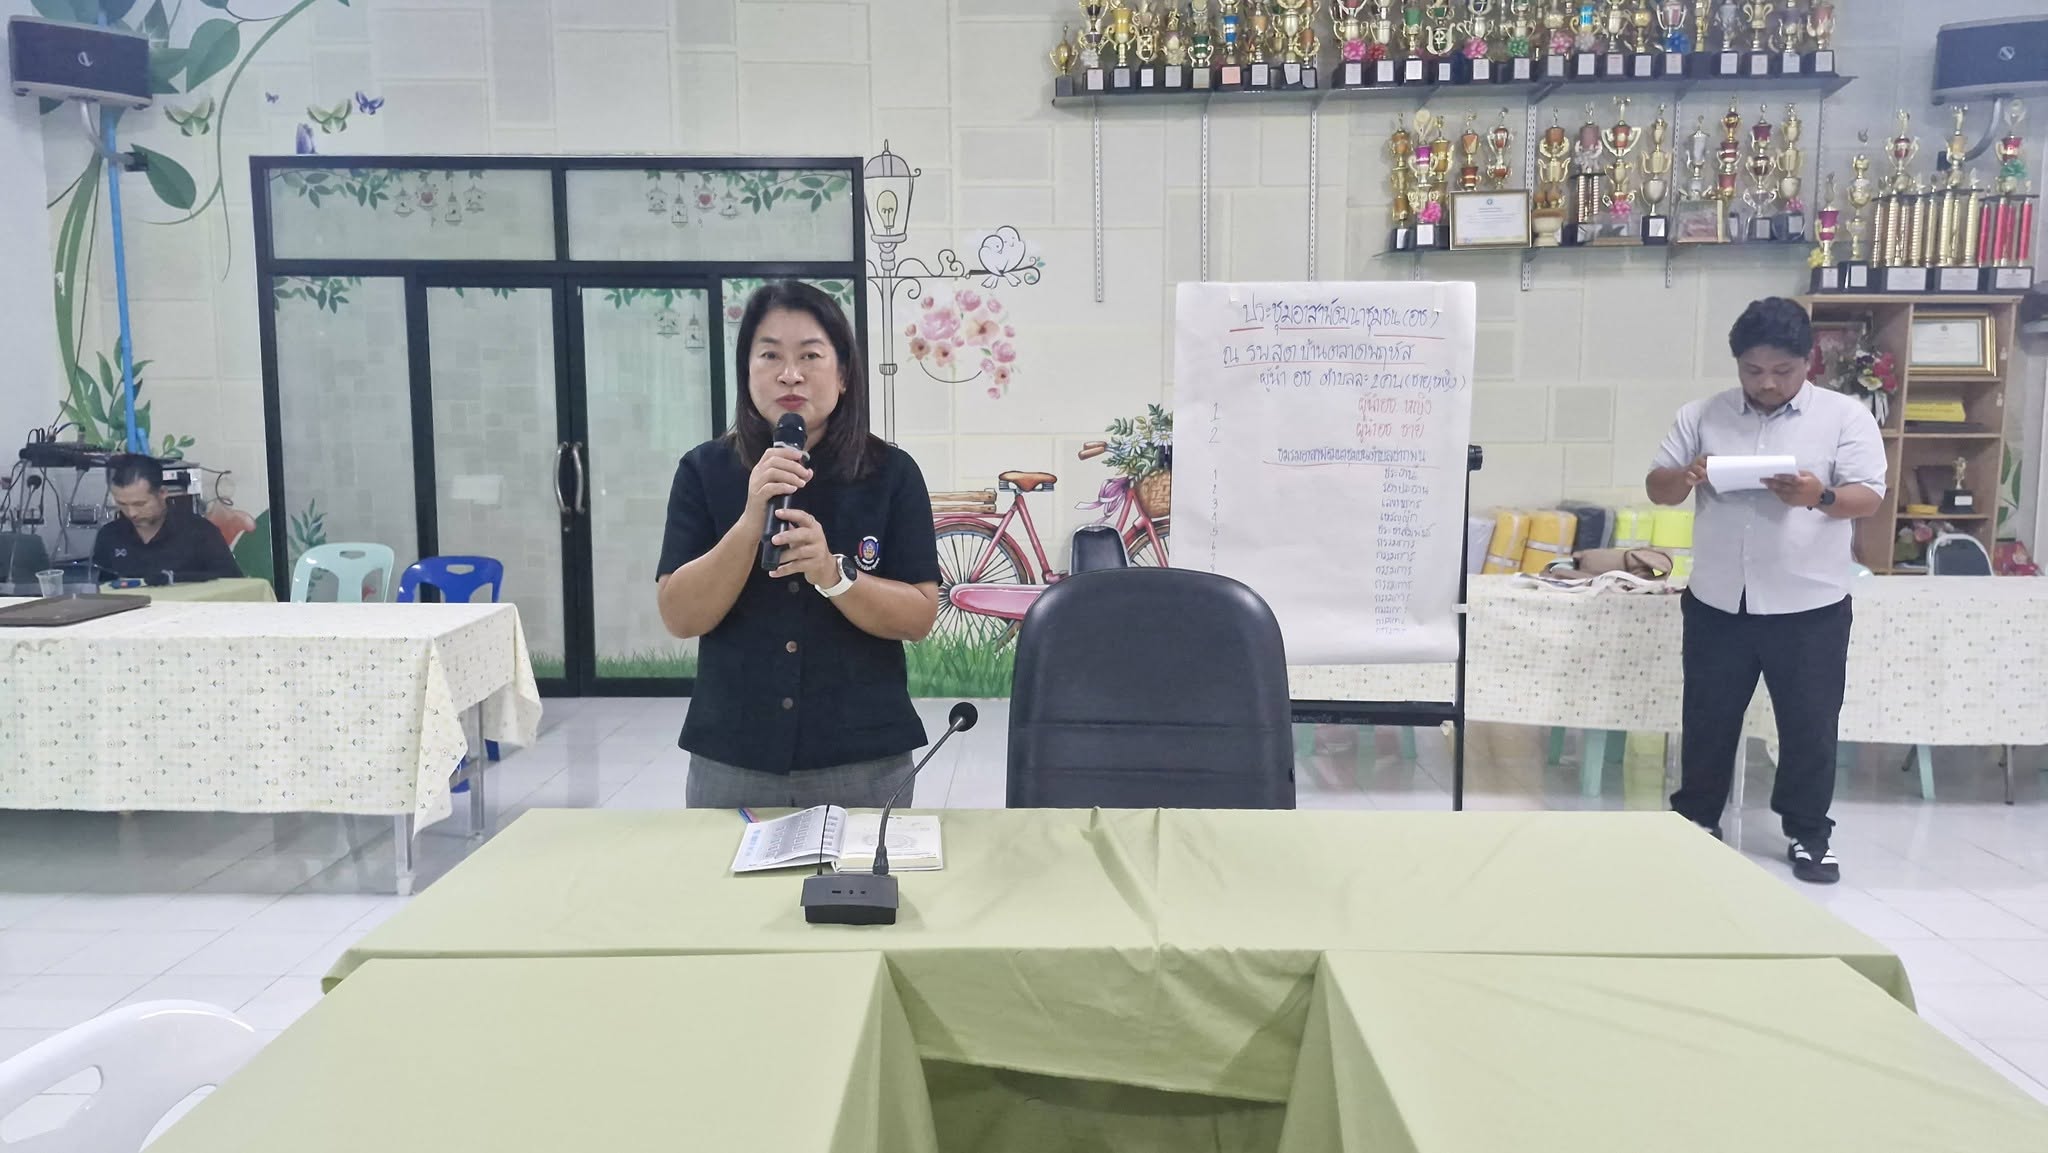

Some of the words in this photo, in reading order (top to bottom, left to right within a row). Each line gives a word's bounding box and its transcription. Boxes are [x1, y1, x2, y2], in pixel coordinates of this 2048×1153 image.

[1222, 346, 1239, 365] ณ
[1259, 365, 1286, 393] ผู้นำ
[1293, 370, 1312, 388] อช
[1319, 367, 1369, 387] ตำบลละ
[1209, 402, 1221, 422] 1
[1208, 426, 1221, 444] 2
[1212, 498, 1219, 510] 3
